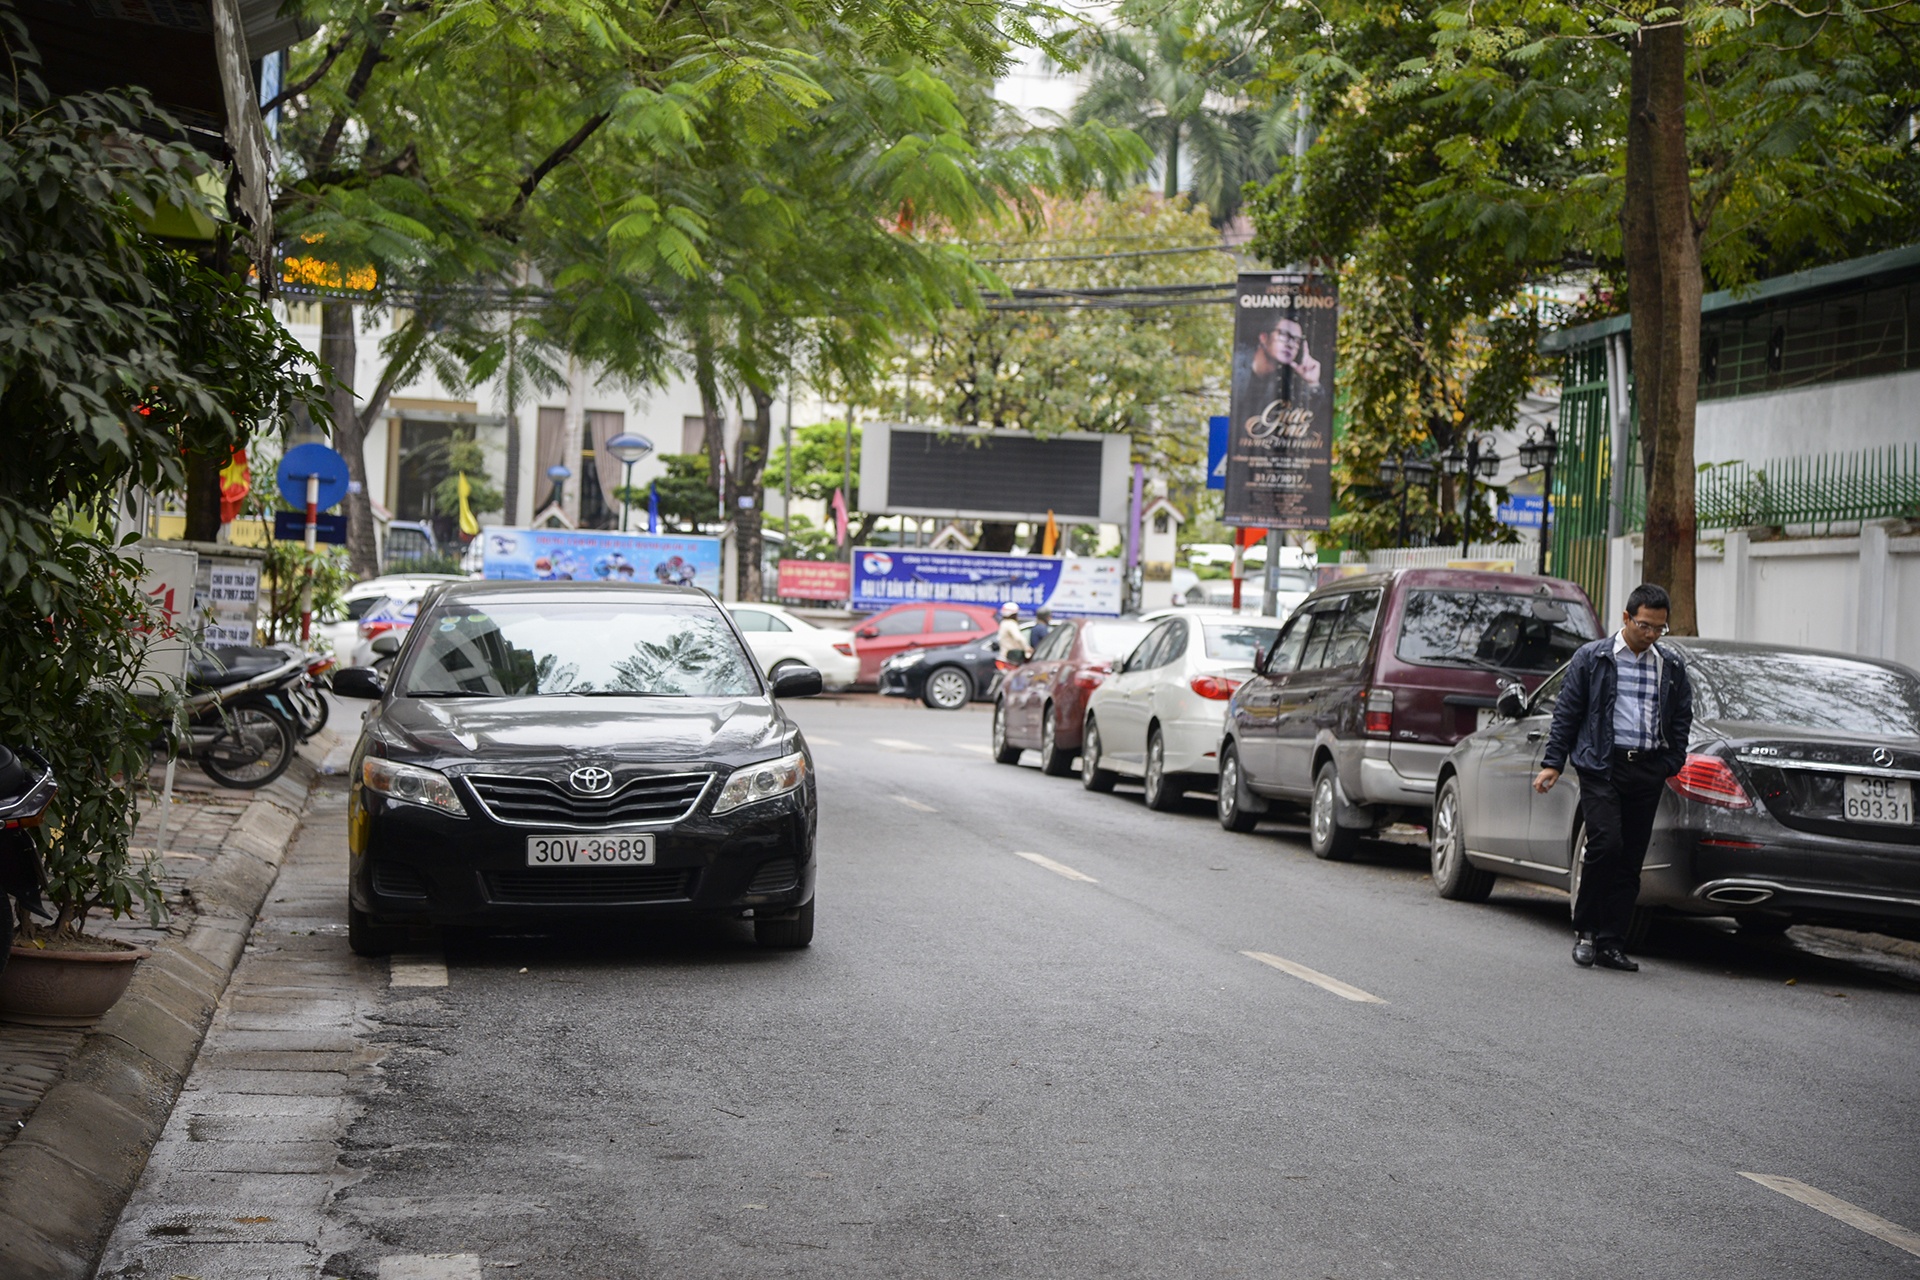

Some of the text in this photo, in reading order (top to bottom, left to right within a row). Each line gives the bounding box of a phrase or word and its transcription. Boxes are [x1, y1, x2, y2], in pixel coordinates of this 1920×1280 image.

[1240, 294, 1291, 308] QUANG
[1751, 747, 1778, 756] 200
[1861, 778, 1897, 799] 30E
[1848, 799, 1909, 822] 693.31
[535, 839, 646, 862] 30V-3689
